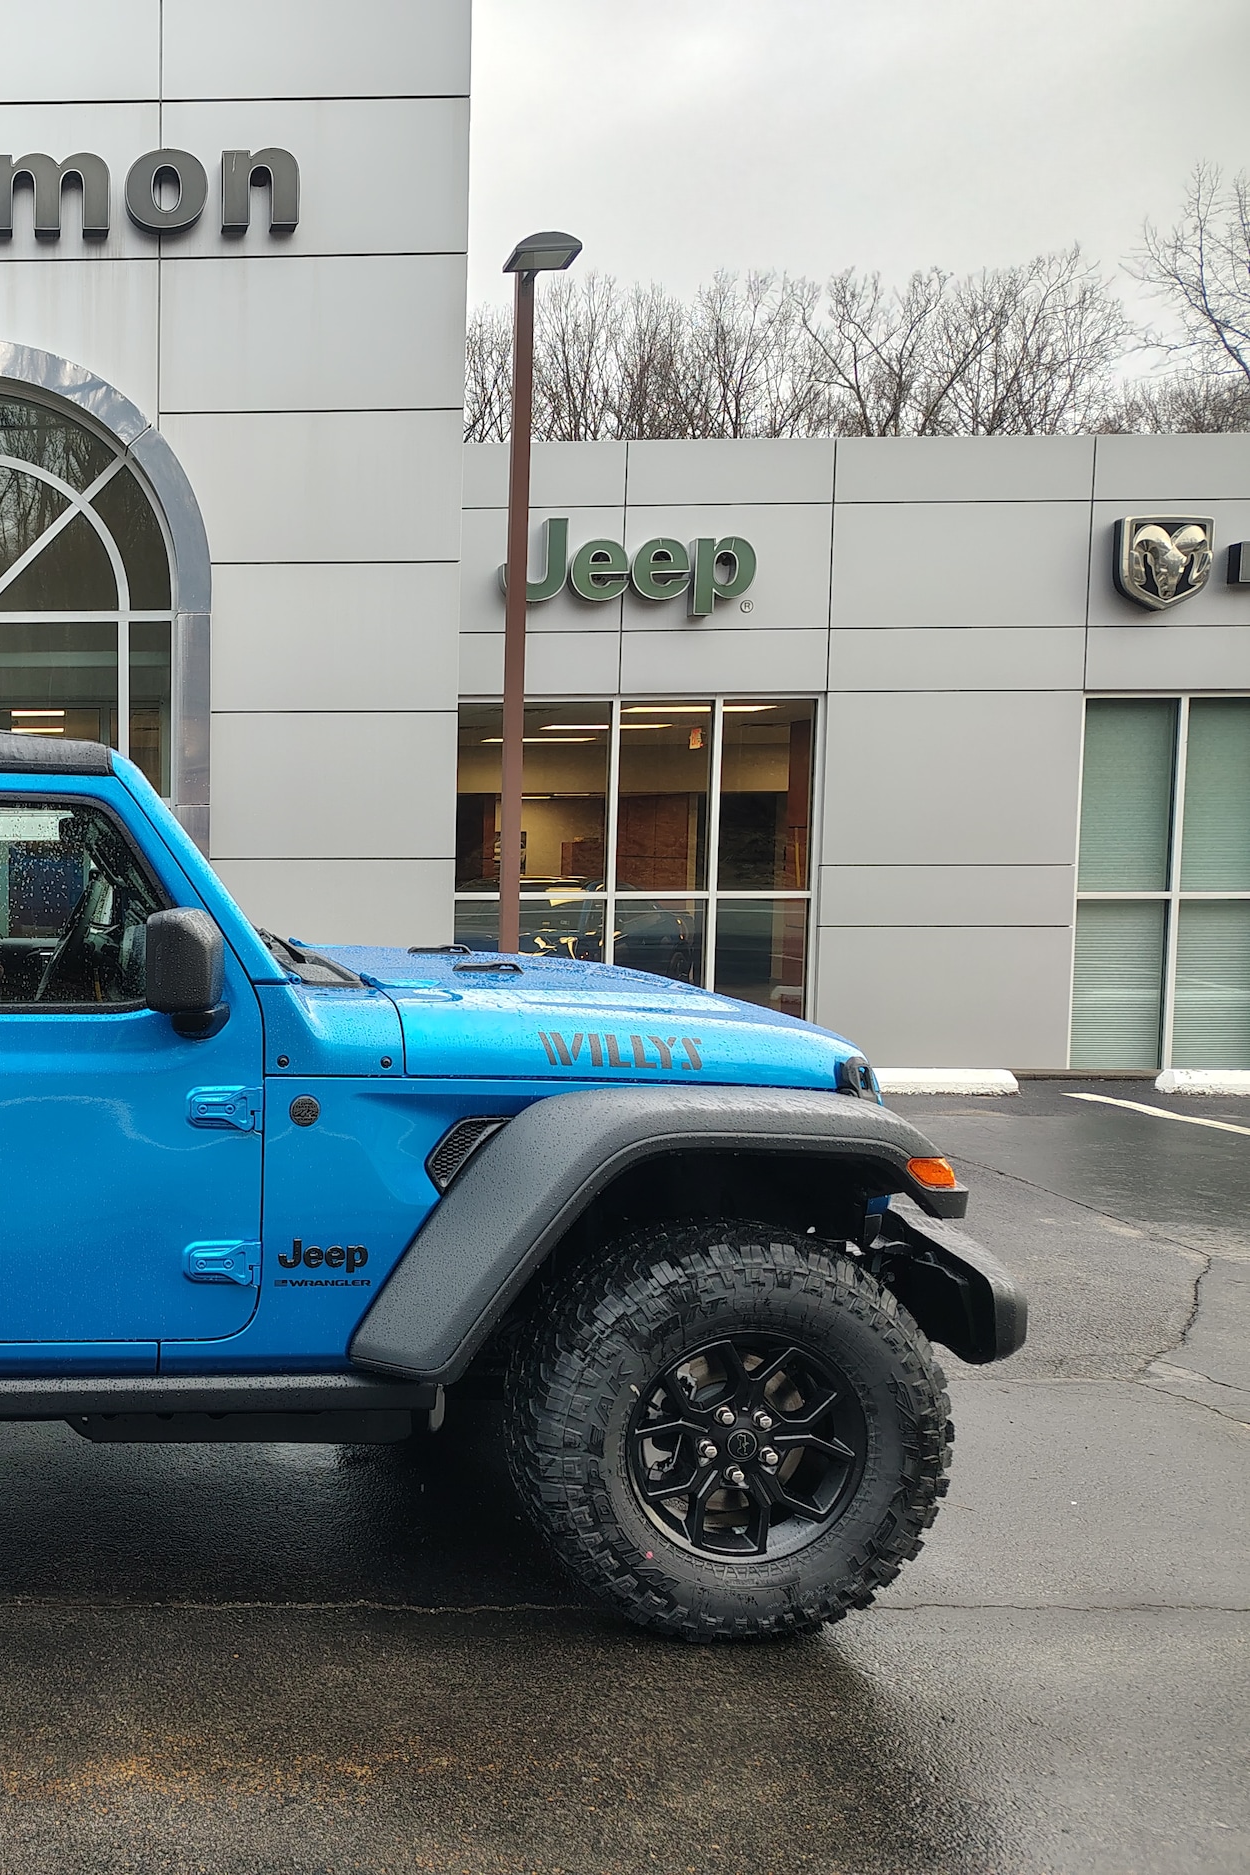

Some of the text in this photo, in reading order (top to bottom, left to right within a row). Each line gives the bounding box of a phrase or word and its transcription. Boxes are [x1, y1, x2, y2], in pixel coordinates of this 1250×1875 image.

[499, 517, 758, 617] Jeep
[537, 1031, 703, 1071] WILLYS
[278, 1238, 369, 1274] Jeep
[289, 1279, 372, 1287] WRANGLER
